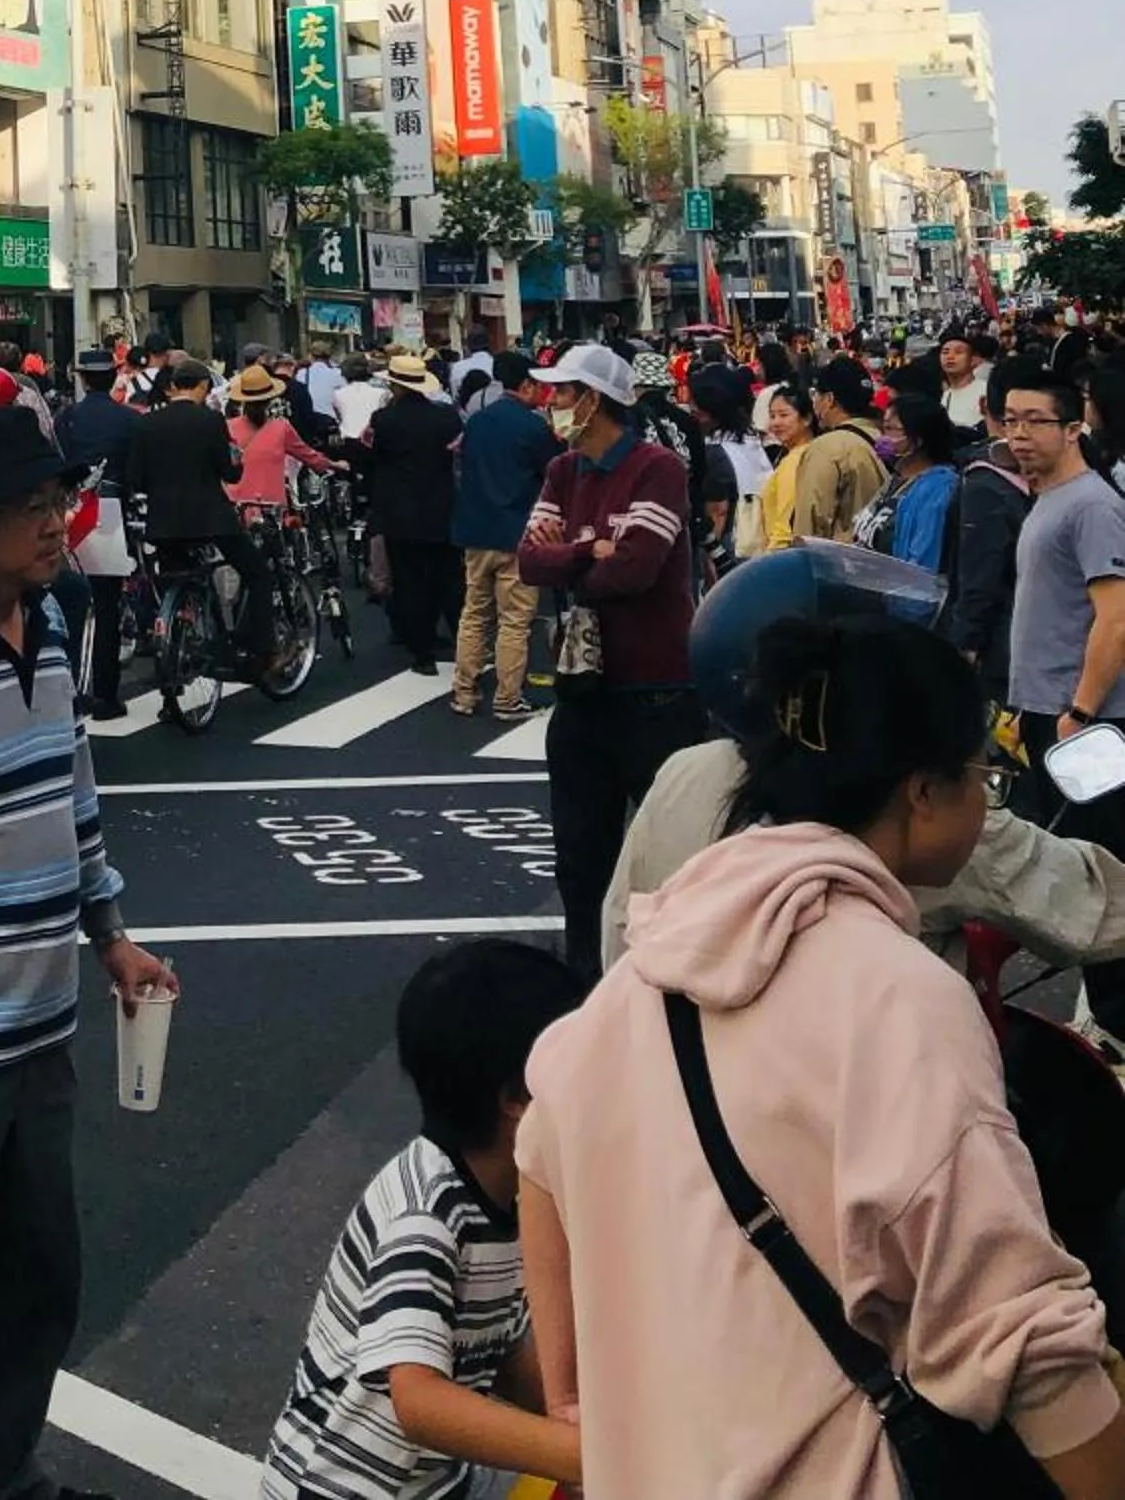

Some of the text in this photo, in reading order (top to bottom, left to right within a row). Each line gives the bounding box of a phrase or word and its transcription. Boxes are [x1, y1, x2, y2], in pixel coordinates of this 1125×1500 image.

[389, 41, 422, 136] 華歌爾
[461, 5, 484, 120] mamaway
